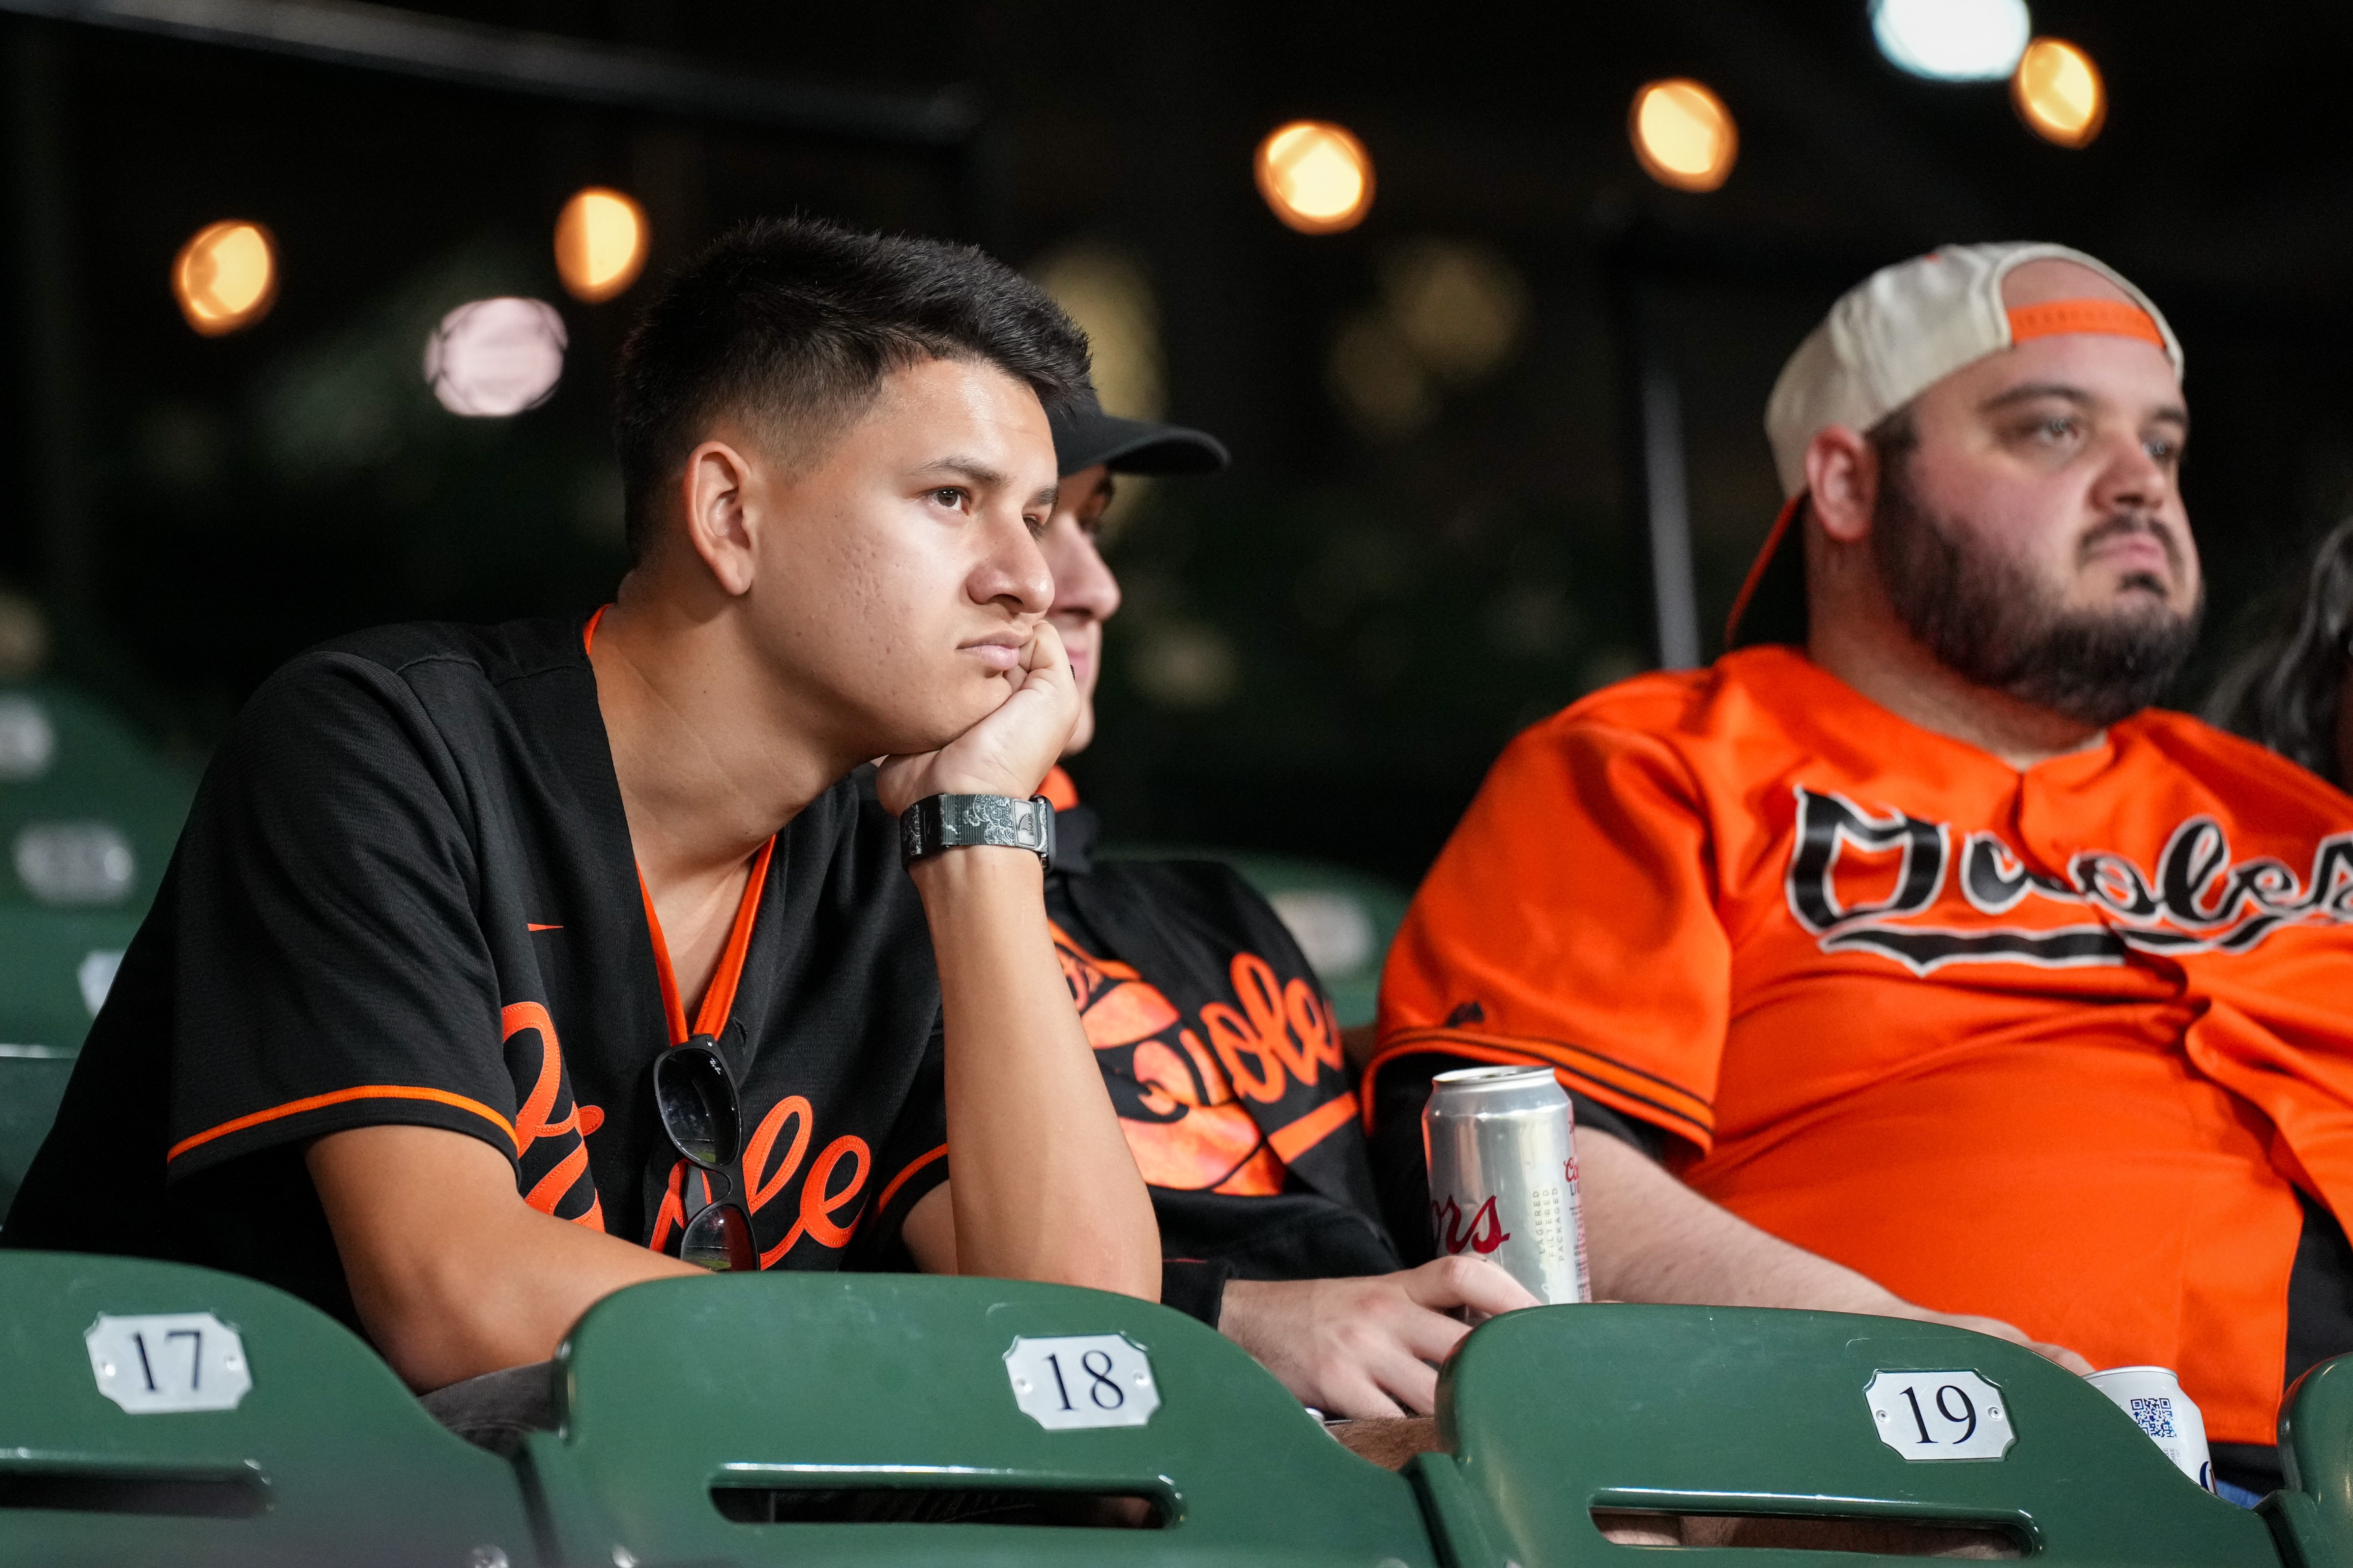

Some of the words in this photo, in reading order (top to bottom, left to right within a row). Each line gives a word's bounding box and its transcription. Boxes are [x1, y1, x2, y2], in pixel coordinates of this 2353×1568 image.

[1532, 1191, 1546, 1255] LAGERED
[1543, 1189, 1555, 1258] FILTERED
[1552, 1188, 1565, 1262] PACKAGED
[131, 1329, 200, 1392] 17
[1041, 1349, 1124, 1411] 18
[1899, 1385, 1977, 1444] 19
